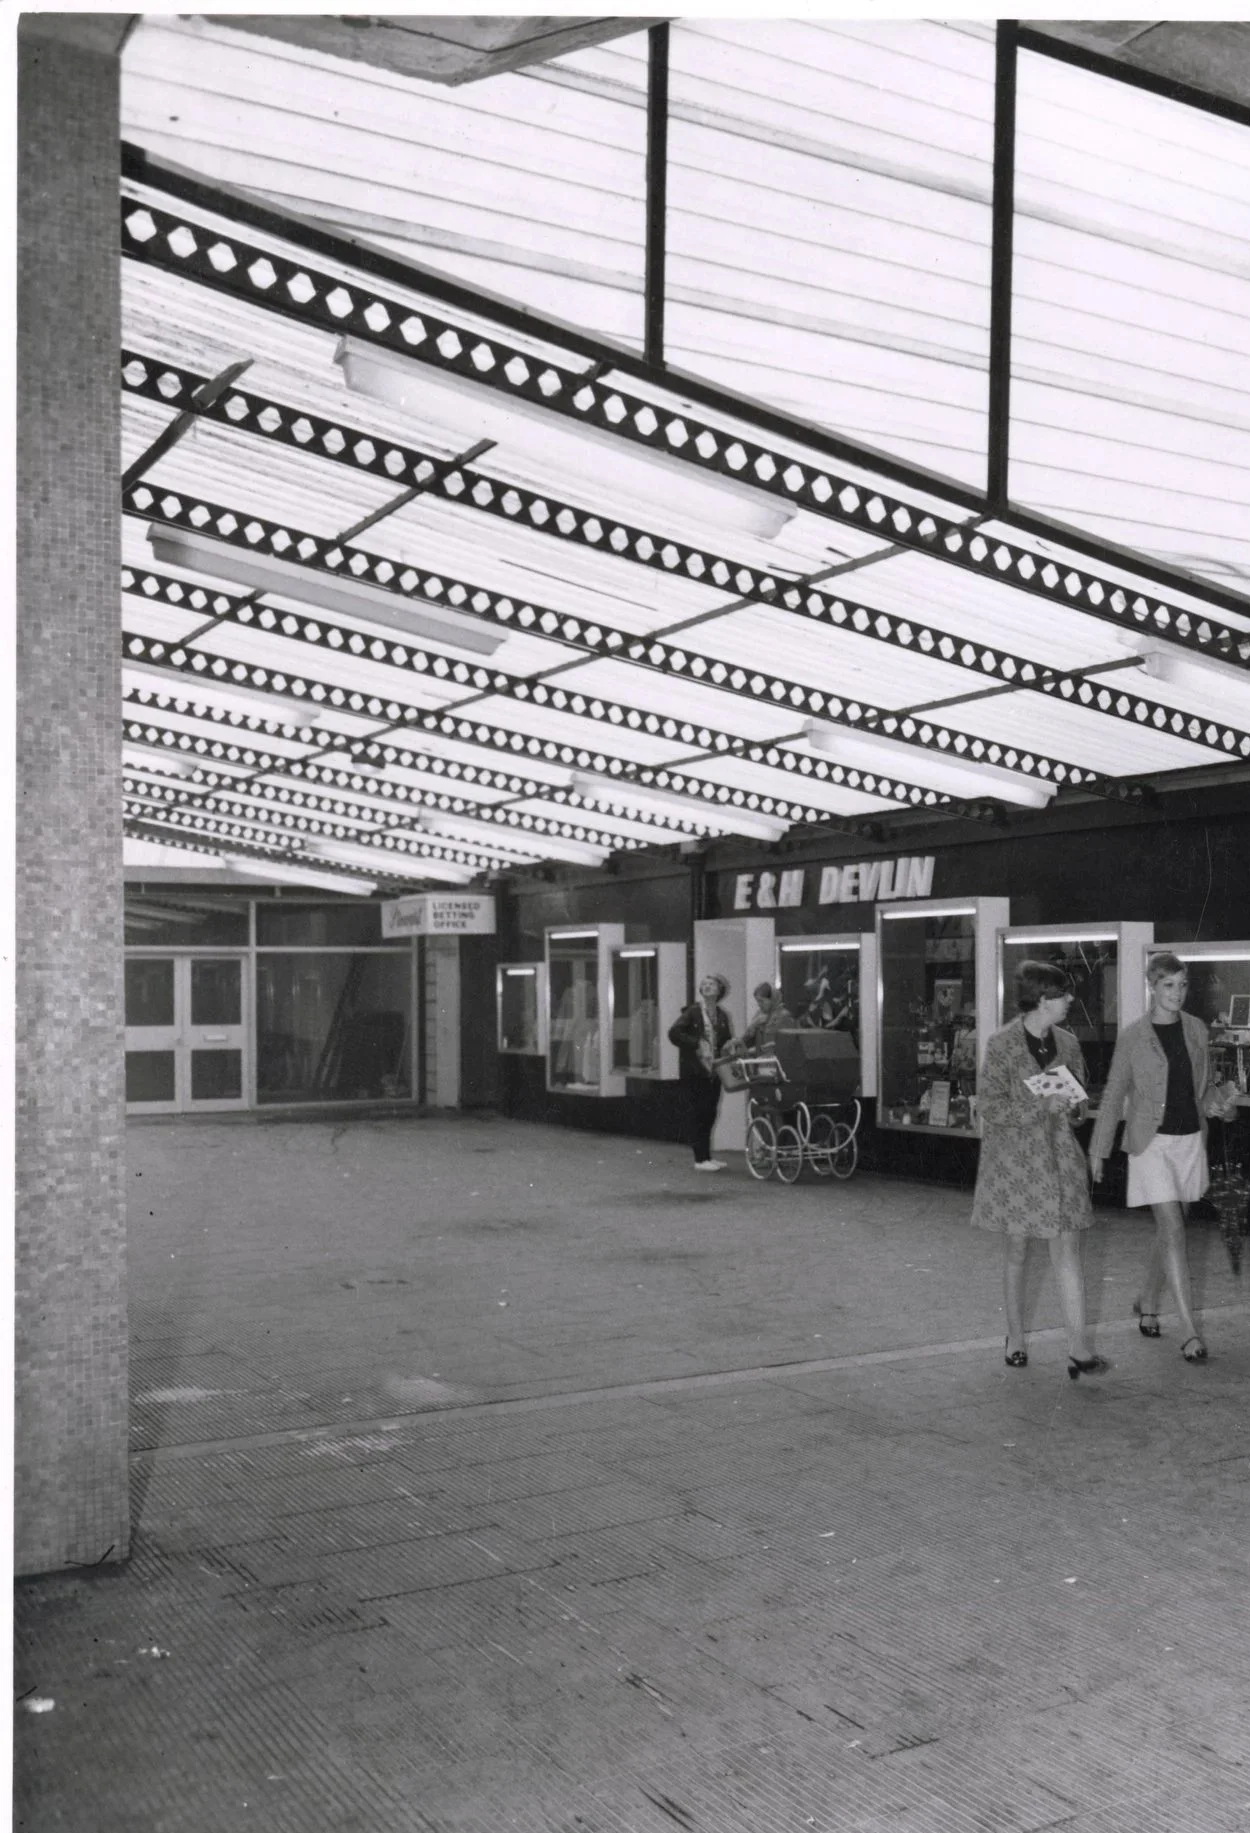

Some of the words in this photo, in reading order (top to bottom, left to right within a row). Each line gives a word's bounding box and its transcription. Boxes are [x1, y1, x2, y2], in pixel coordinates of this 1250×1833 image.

[818, 856, 935, 905] DEVLIN
[432, 902, 480, 910] LICENSED
[433, 911, 475, 919] BETTING
